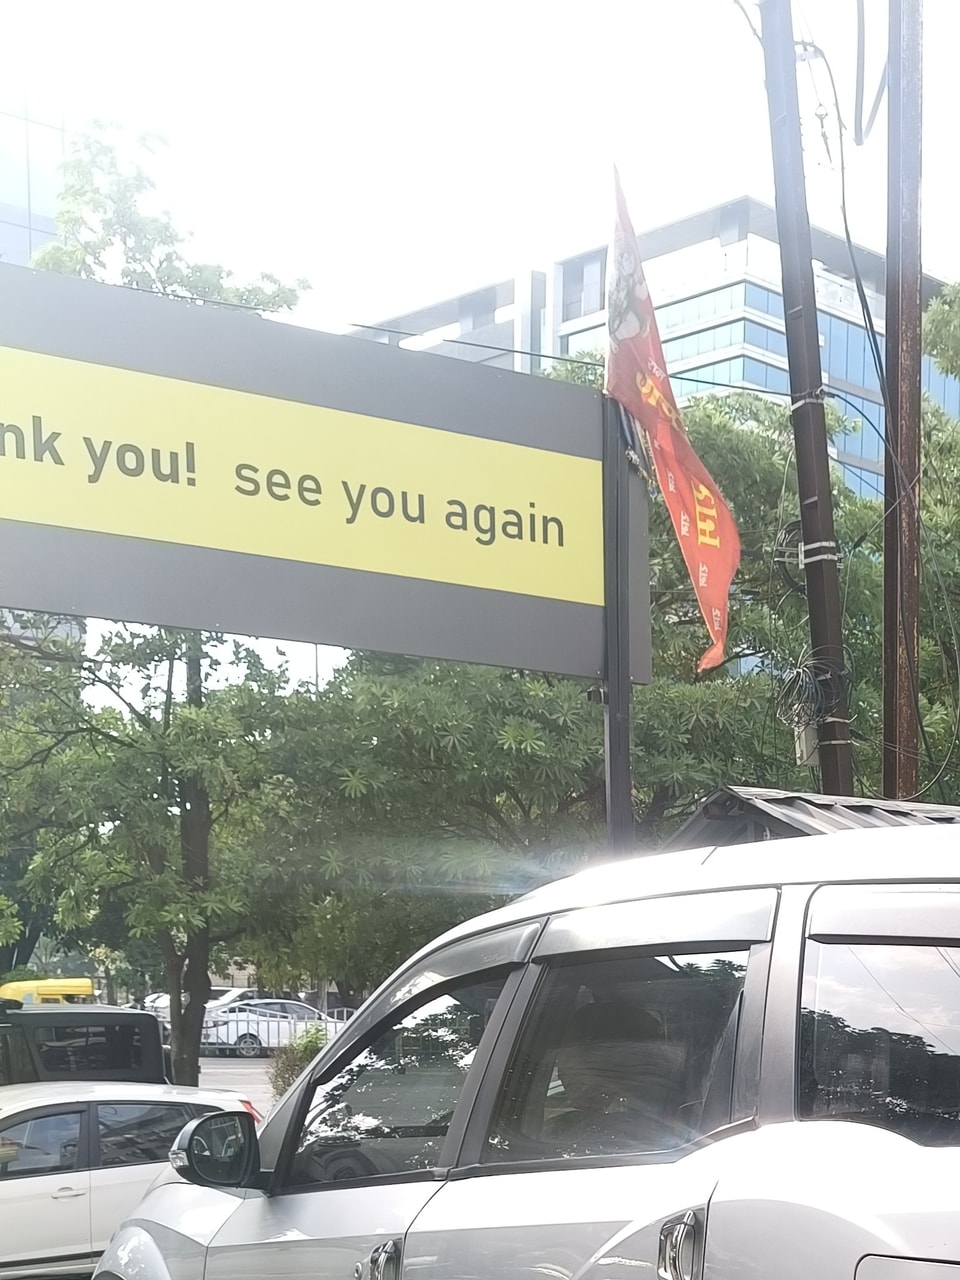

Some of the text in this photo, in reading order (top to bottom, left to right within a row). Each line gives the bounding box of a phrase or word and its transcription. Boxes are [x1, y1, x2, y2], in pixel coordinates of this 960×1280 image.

[82, 436, 197, 487] you!
[234, 462, 323, 507] see
[341, 479, 426, 526] you
[445, 502, 566, 547] again
